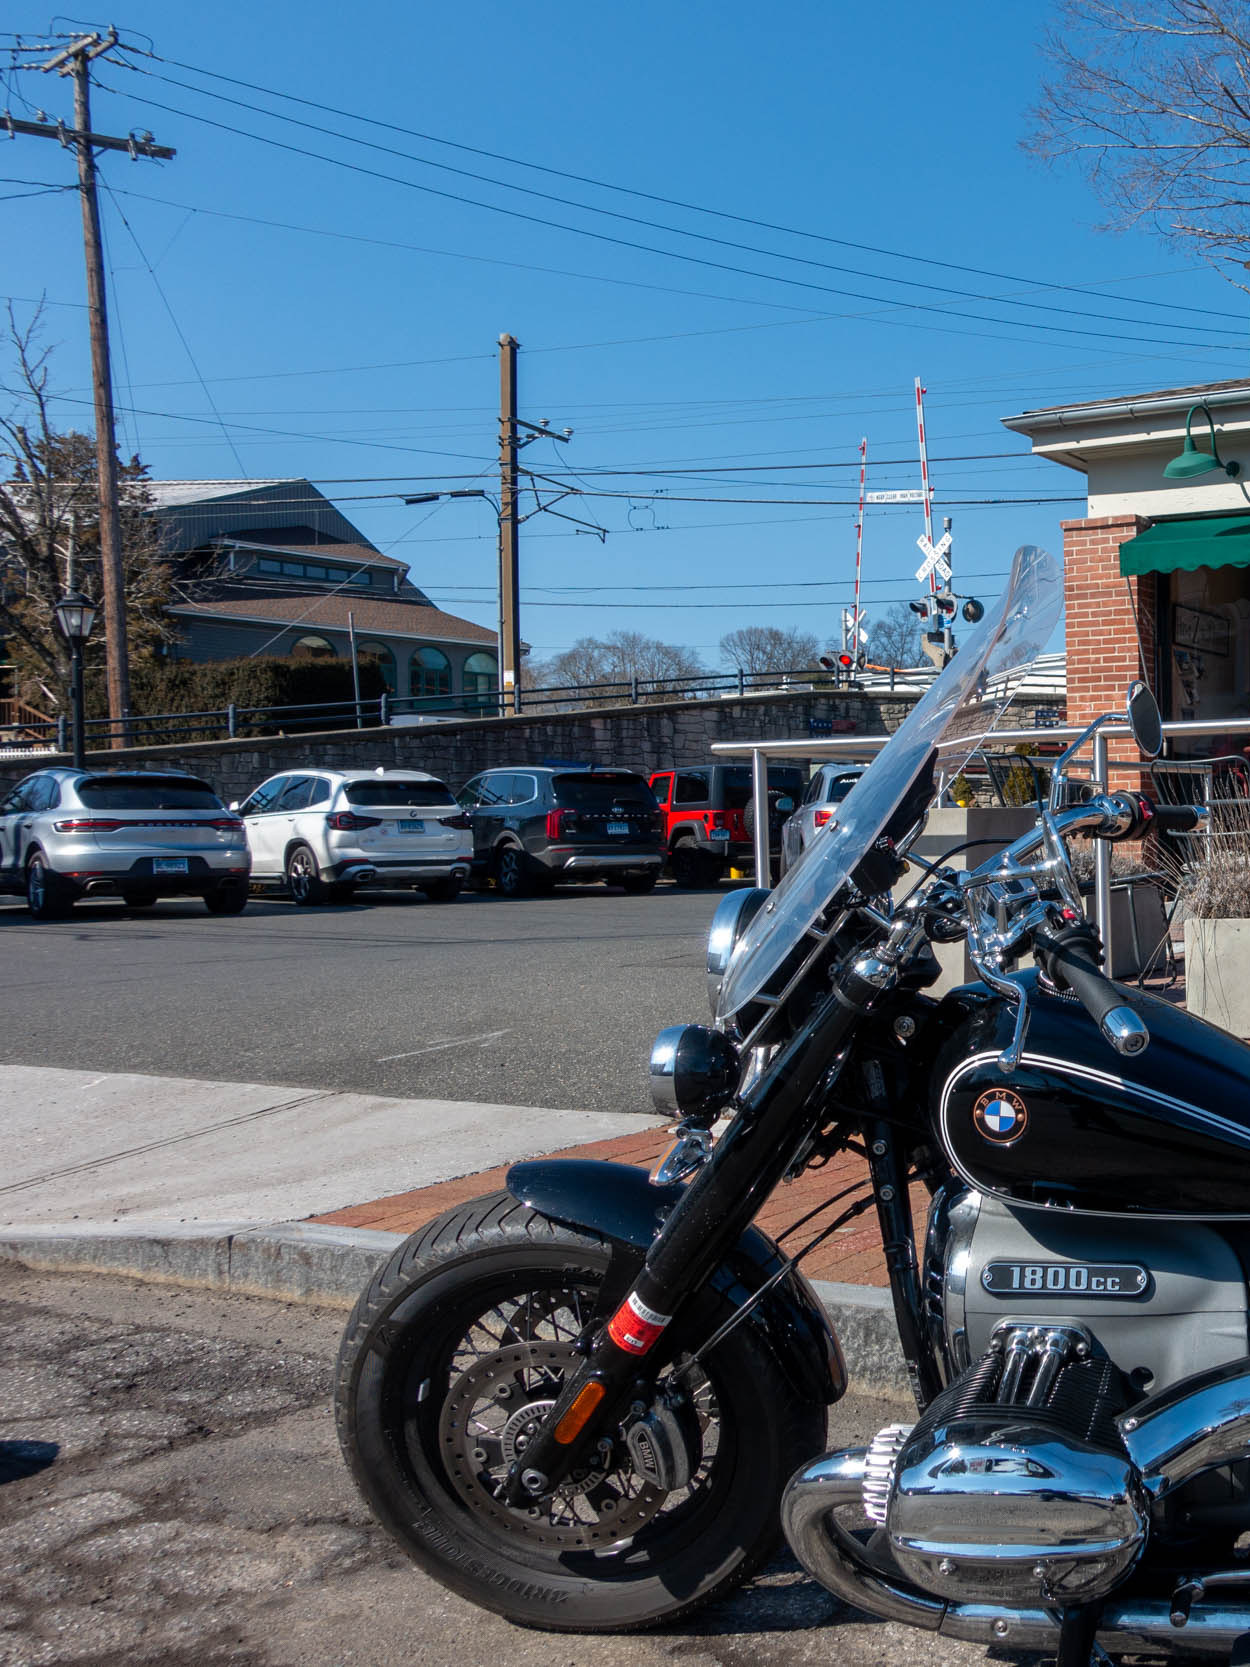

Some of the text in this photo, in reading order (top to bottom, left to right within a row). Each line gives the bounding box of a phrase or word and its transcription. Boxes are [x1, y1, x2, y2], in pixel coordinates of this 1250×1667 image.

[918, 534, 952, 580] CROSSING
[980, 1092, 1022, 1109] BMW
[1009, 1266, 1121, 1291] 1800cc
[640, 1441, 655, 1468] BMW
